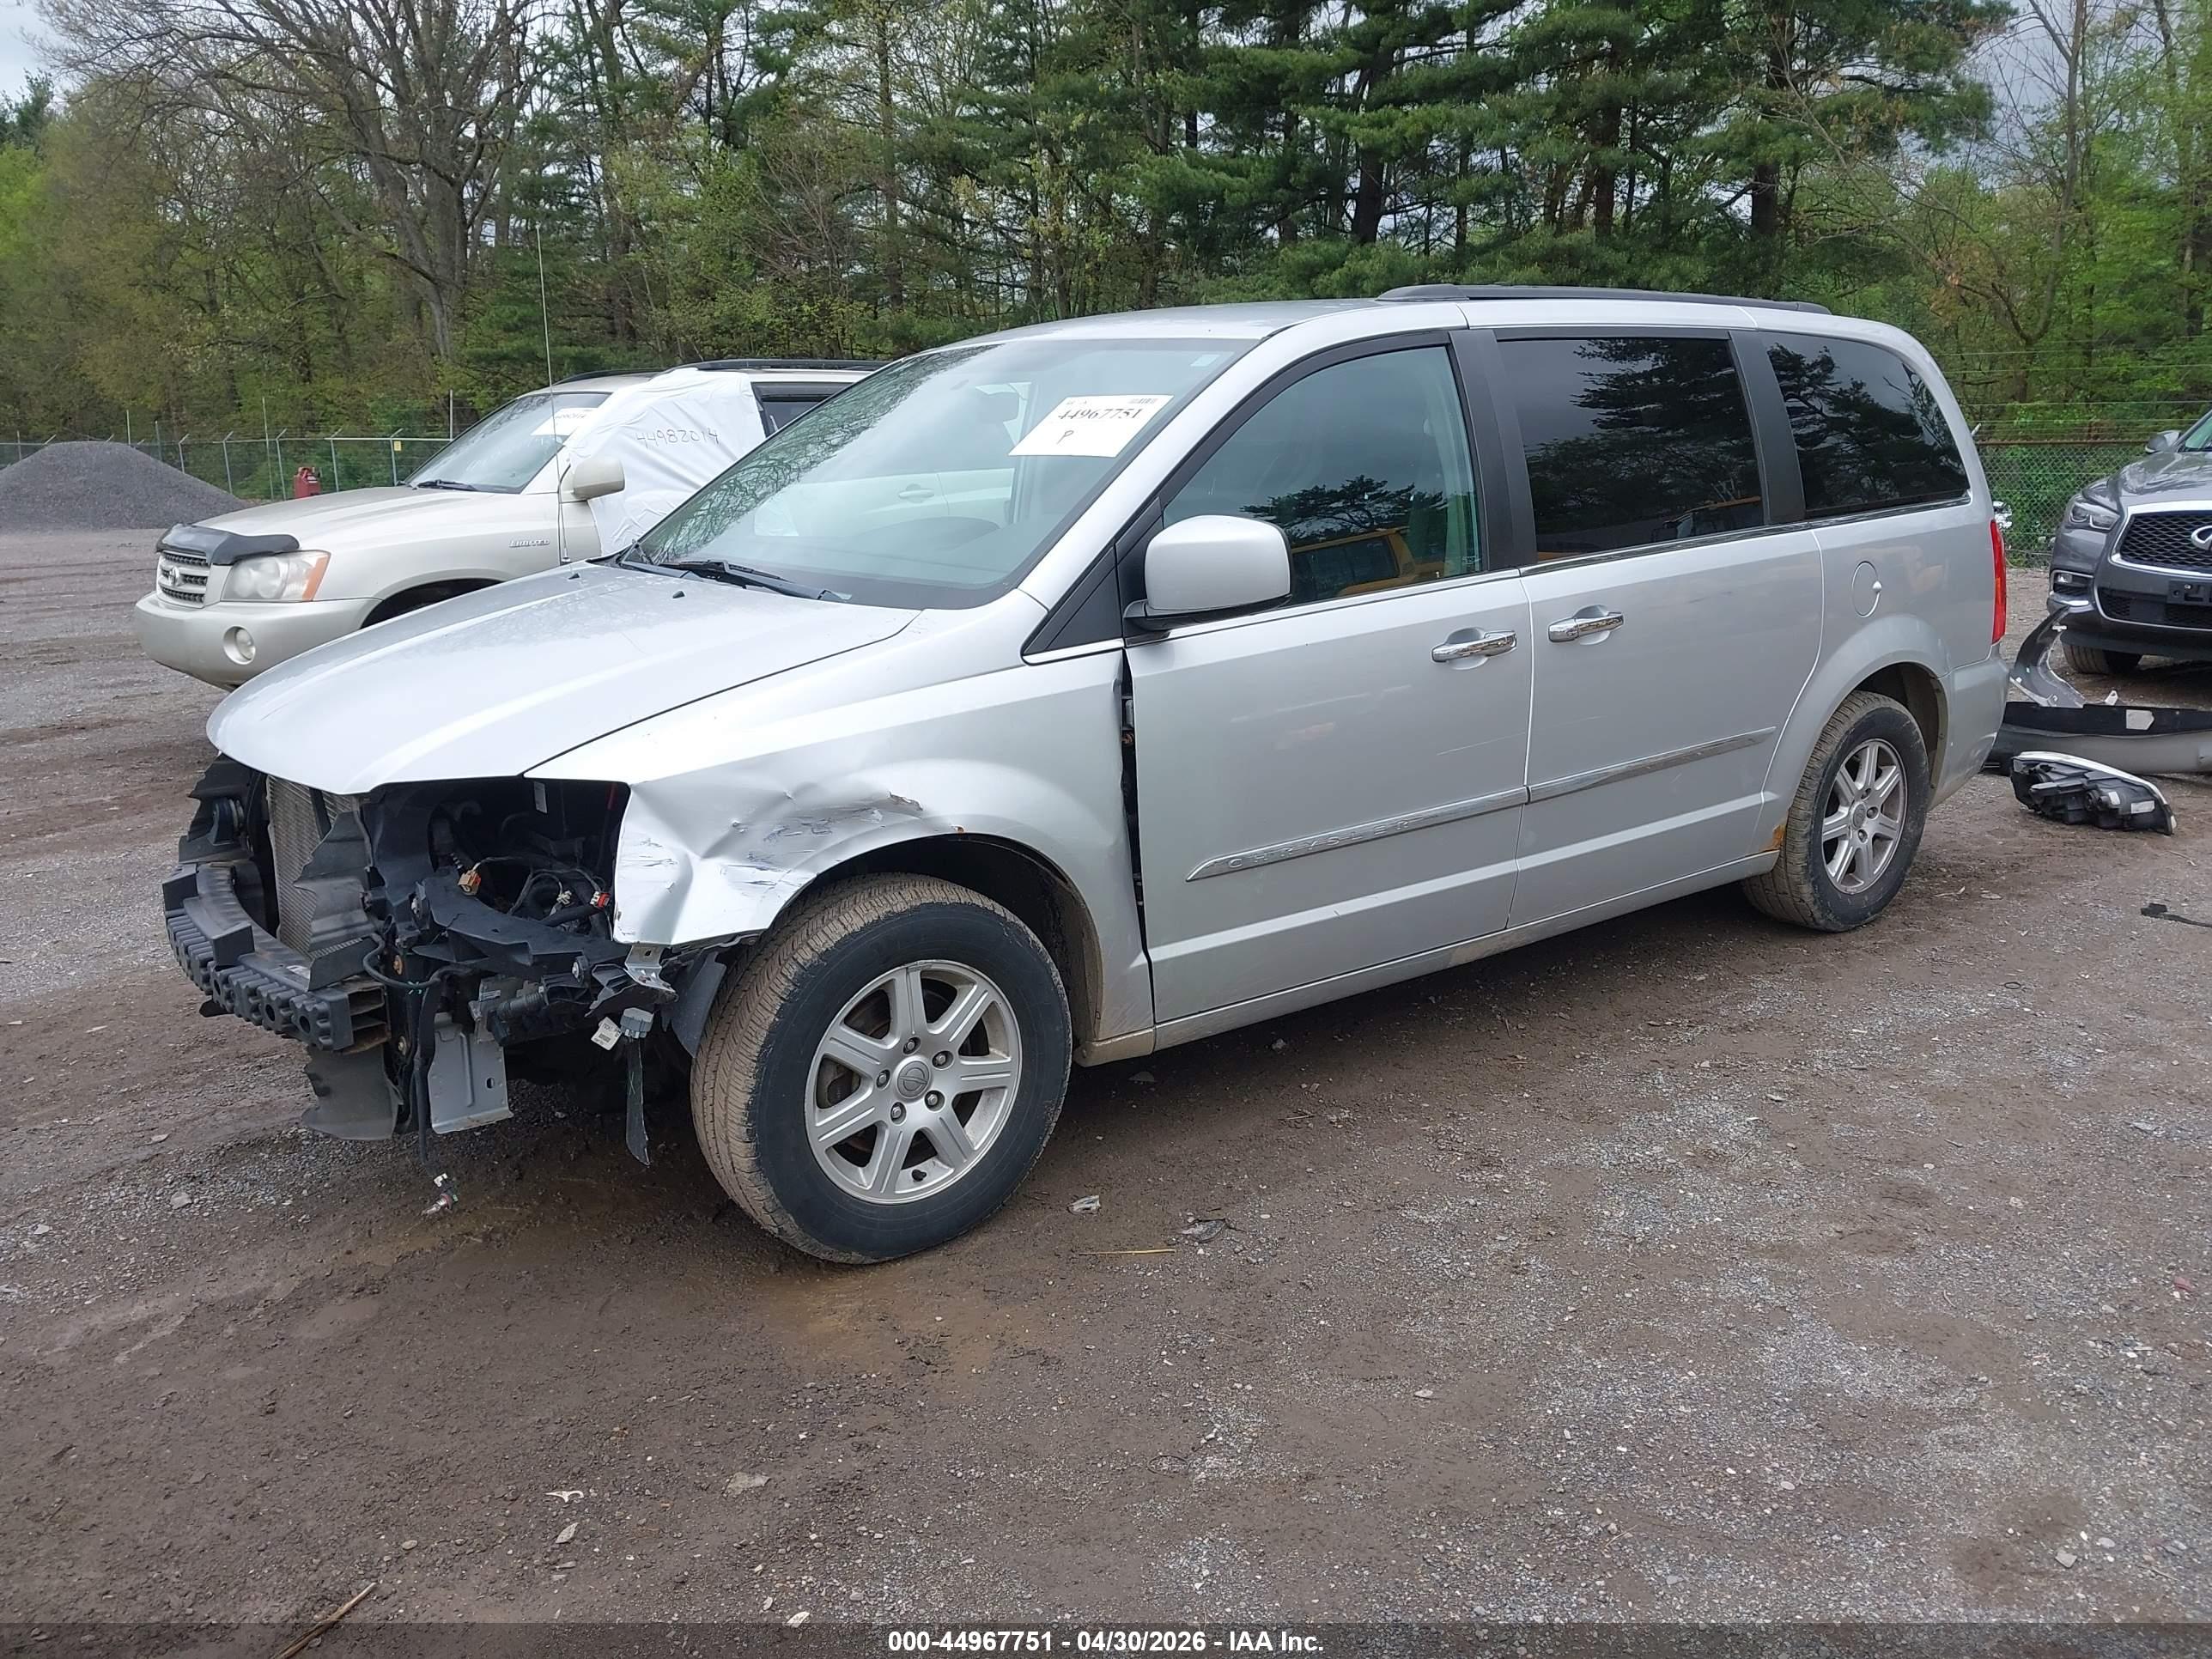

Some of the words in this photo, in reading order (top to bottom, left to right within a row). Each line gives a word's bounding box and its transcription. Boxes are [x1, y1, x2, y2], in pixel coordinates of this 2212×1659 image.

[1058, 408, 1144, 420] 44967751
[635, 428, 720, 449] 44982014
[1228, 818, 1409, 869] CHRYSLER
